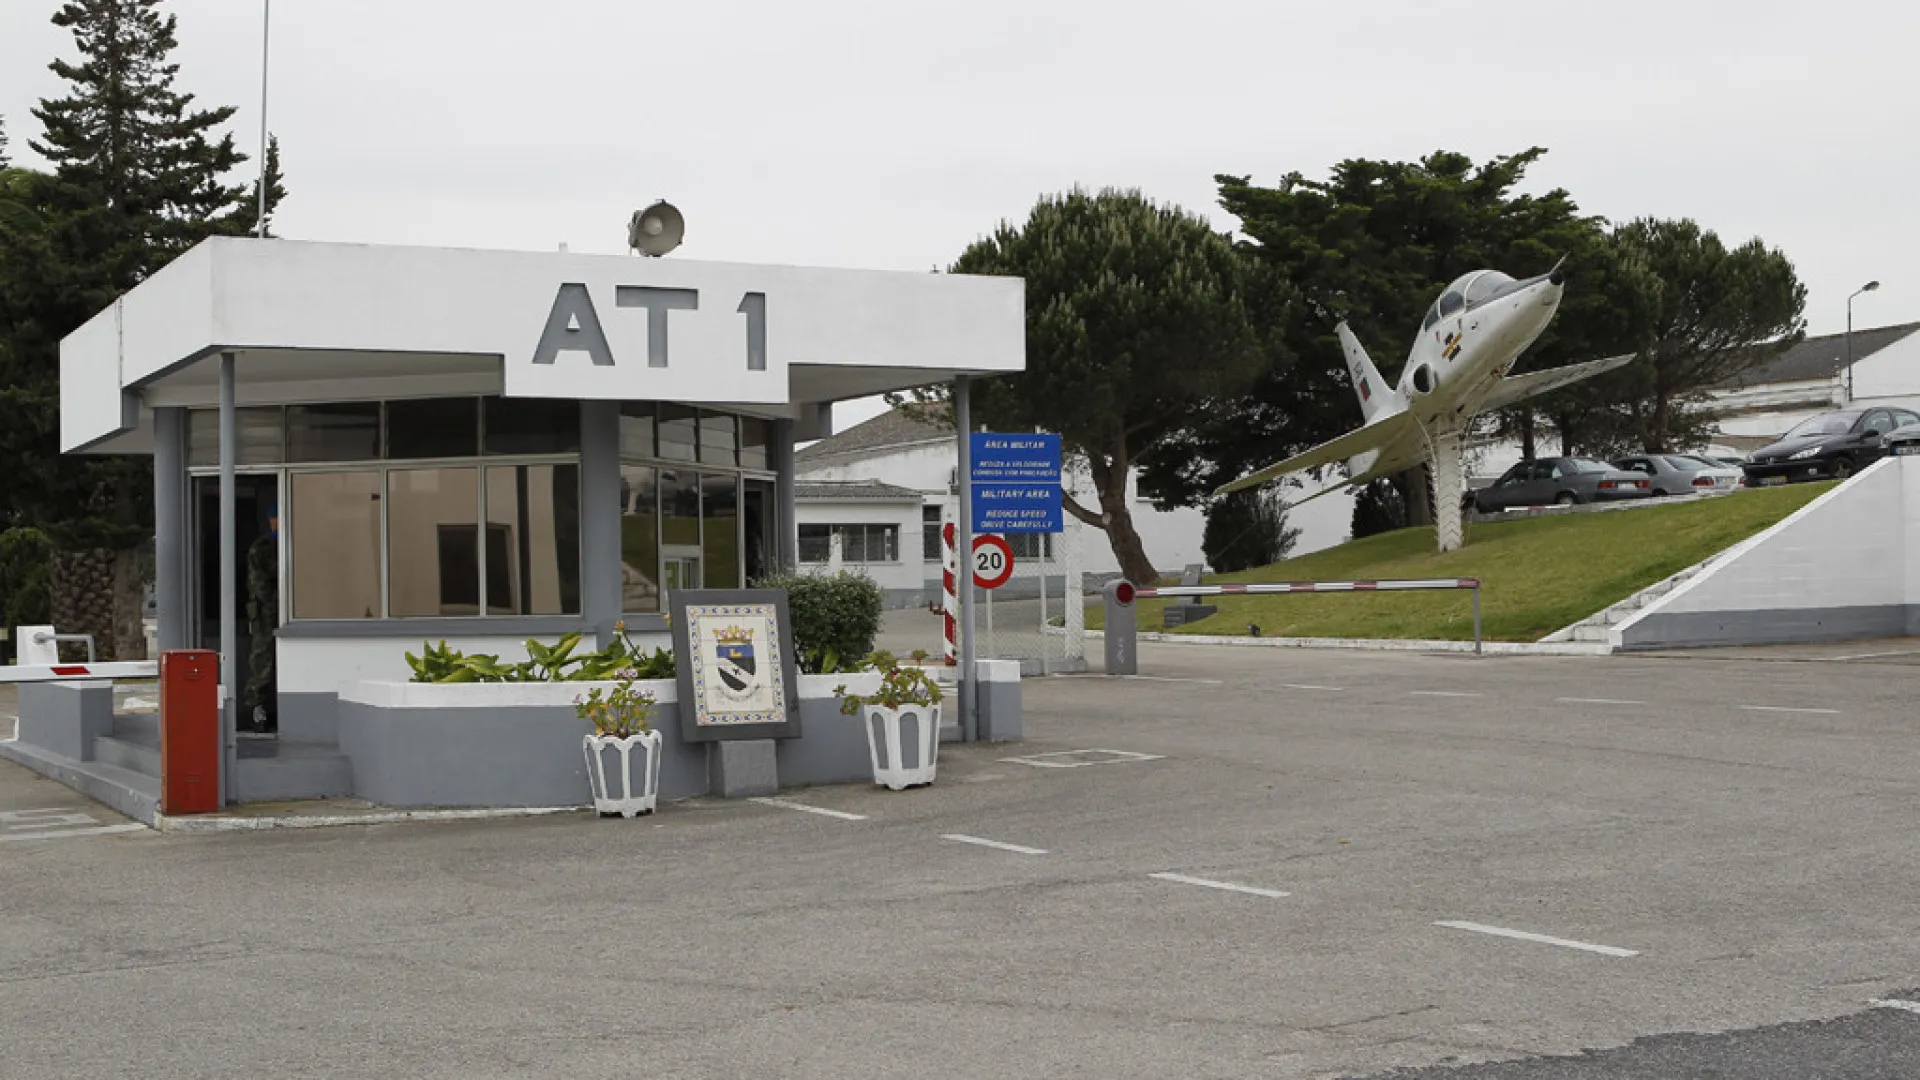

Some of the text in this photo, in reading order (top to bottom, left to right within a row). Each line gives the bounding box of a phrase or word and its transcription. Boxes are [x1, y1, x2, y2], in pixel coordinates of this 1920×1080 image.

[736, 291, 767, 371] 1
[1010, 441, 1045, 449] MILITAR
[981, 490, 1050, 498] MILITARY AREA
[986, 510, 1047, 518] REDUCE SPEED
[977, 552, 1002, 570] 20
